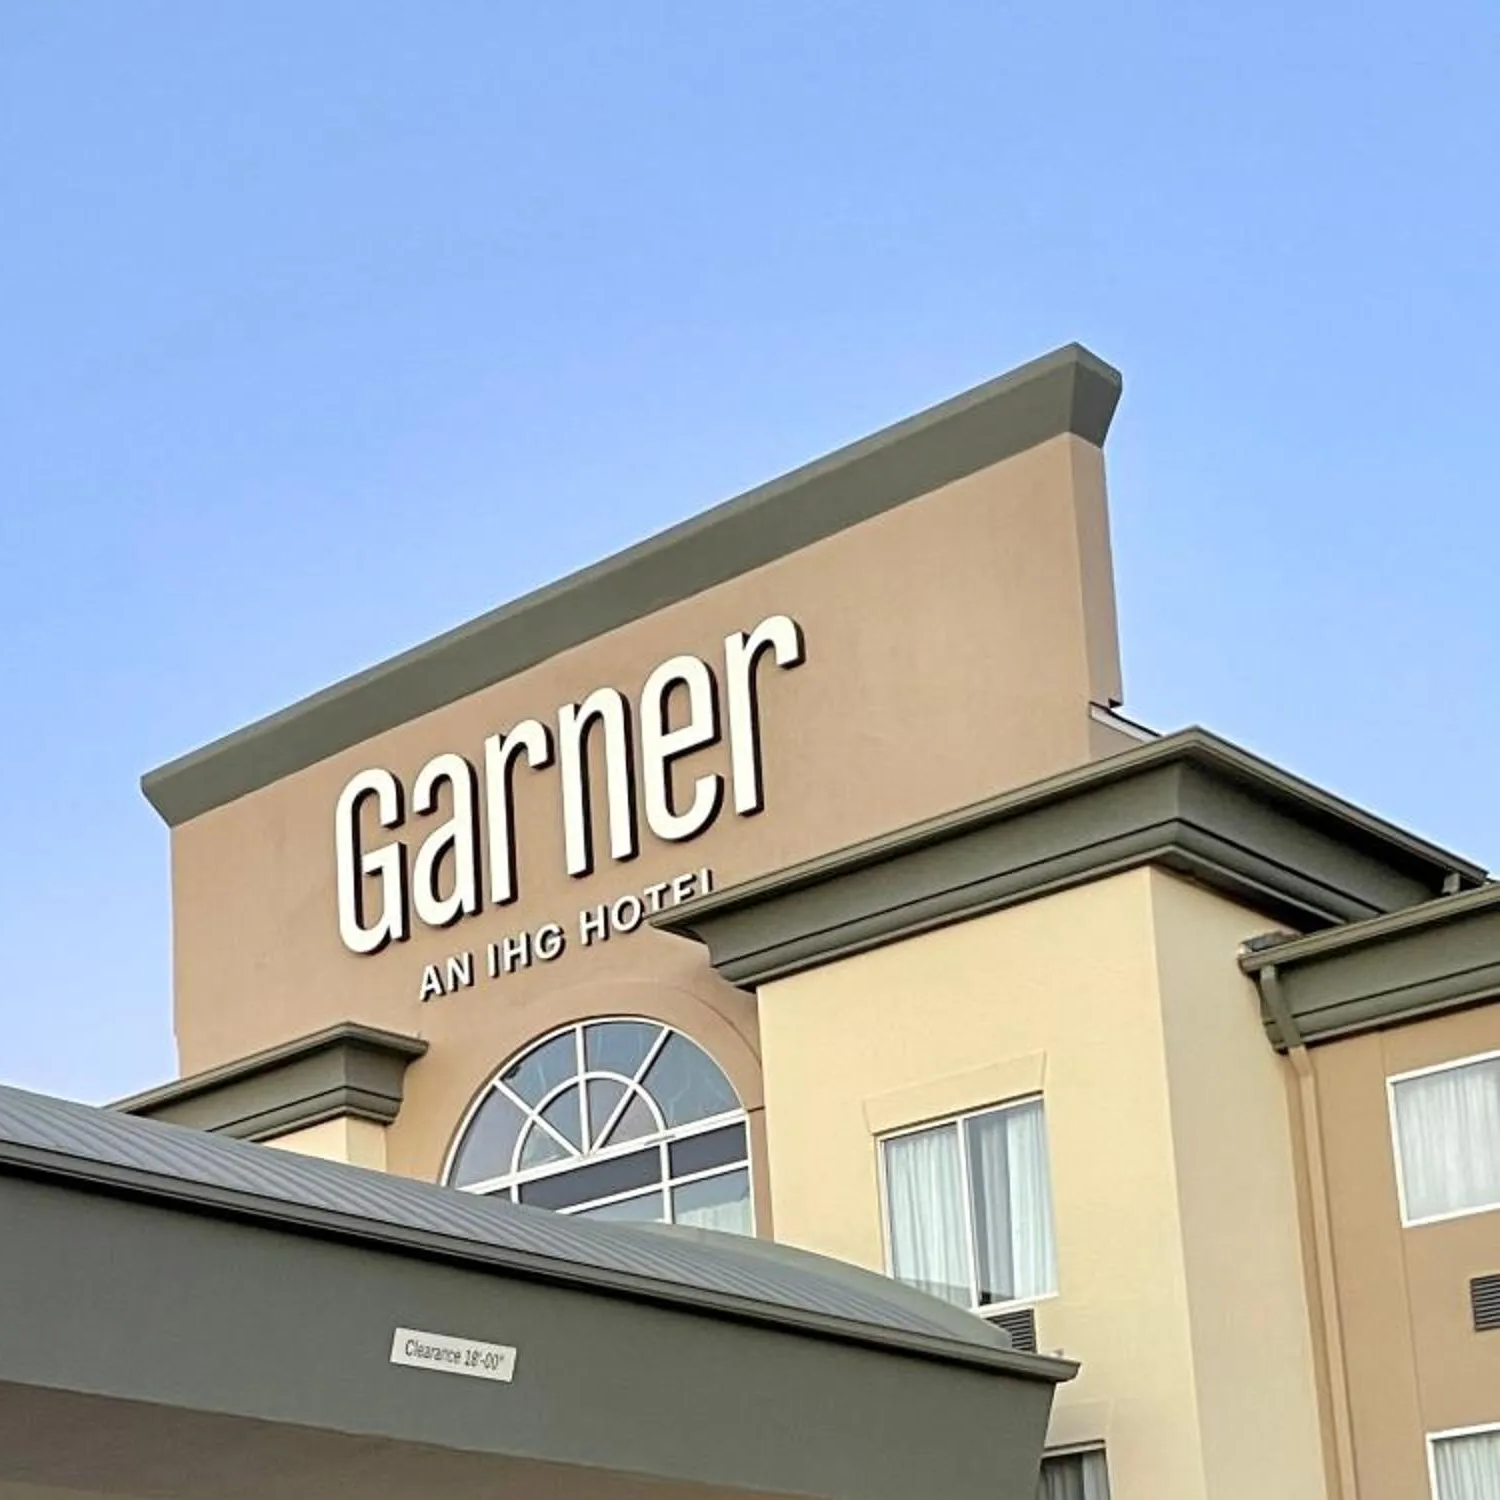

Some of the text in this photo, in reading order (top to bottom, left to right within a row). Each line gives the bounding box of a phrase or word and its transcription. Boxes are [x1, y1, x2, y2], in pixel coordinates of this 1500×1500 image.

[334, 615, 804, 955] Garner
[419, 951, 474, 1002] AN
[487, 923, 567, 979] IHG
[405, 1339, 462, 1365] Clearance
